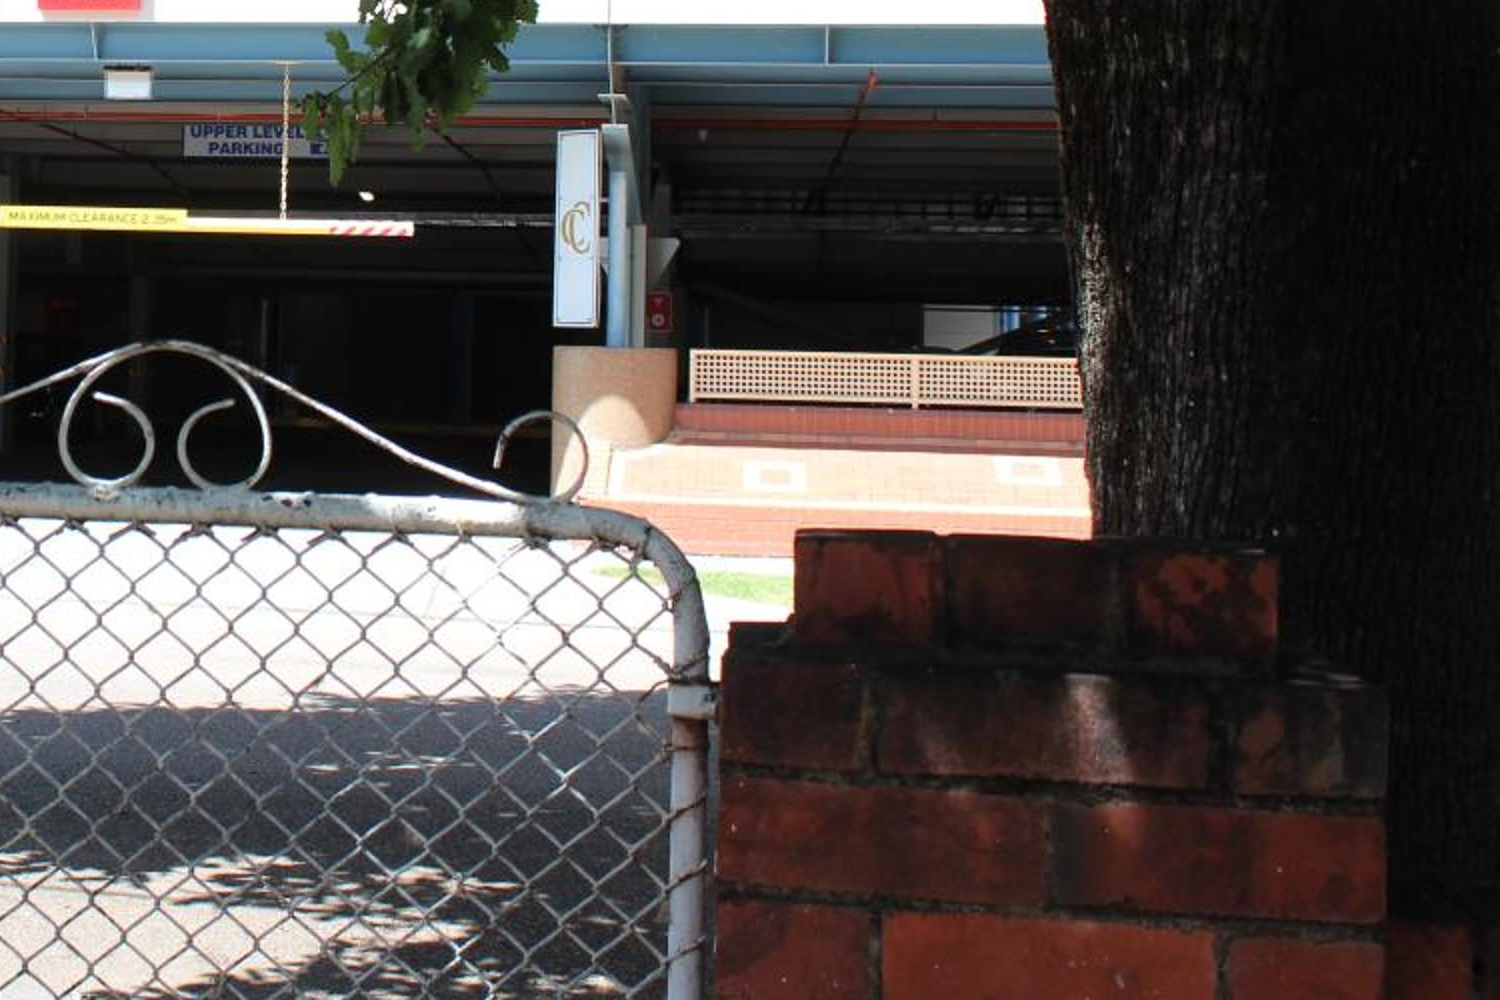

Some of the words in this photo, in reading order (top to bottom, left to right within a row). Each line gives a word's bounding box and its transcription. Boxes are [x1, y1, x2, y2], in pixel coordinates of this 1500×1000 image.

[190, 122, 247, 138] UPPER
[208, 141, 284, 155] PARKING
[8, 210, 67, 222] MAXIMUM
[68, 212, 138, 225] CLEARANCE
